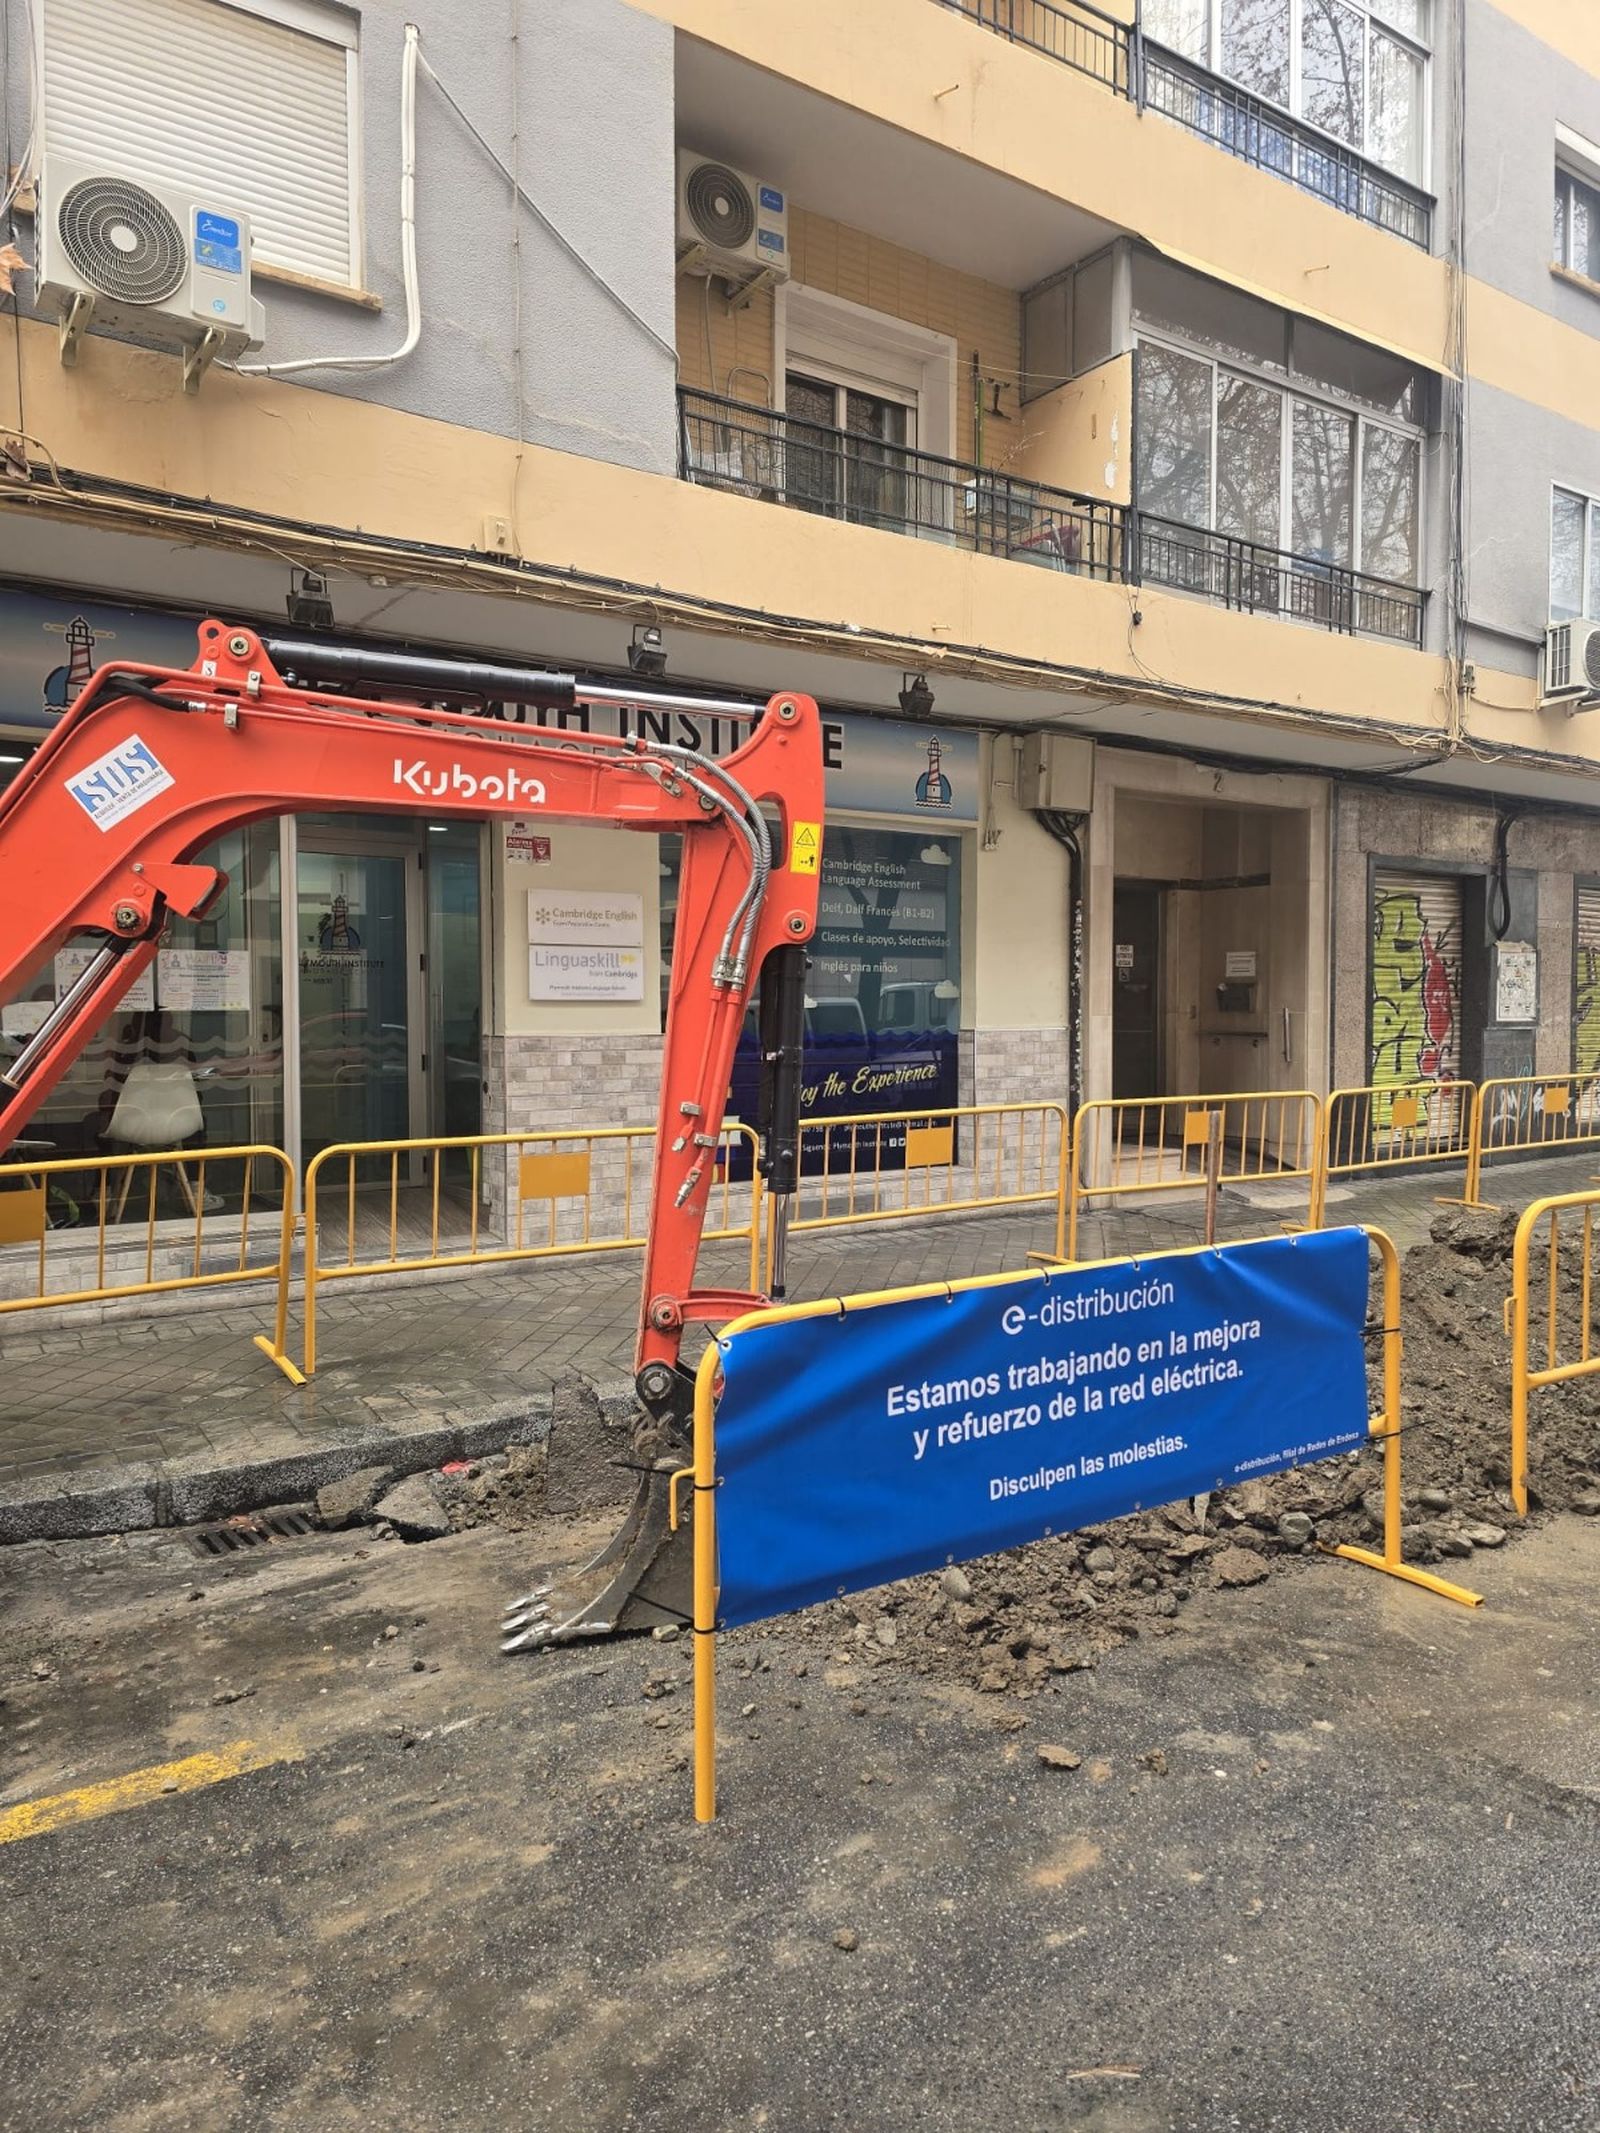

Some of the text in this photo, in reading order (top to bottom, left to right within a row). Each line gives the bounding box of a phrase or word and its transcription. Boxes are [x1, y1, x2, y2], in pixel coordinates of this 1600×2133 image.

[393, 759, 546, 803] Kubota
[822, 858, 907, 876] Cambridge English
[822, 874, 921, 890] Language Assessment
[552, 908, 638, 923] Cambridge English
[821, 931, 850, 943] Clases
[852, 933, 864, 944] de
[866, 935, 897, 947] apoyo,
[535, 951, 620, 971] Linguaskill
[821, 961, 898, 974] Inglés para niños
[822, 1071, 847, 1098] the
[1001, 1281, 1174, 1335] e-distribución
[886, 1320, 1262, 1416] Estamos trabajando en la mejora
[913, 1358, 1244, 1460] y refuerzo de la red eléctrica.
[1297, 1445, 1306, 1455] de
[1327, 1437, 1336, 1446] de
[990, 1433, 1188, 1500] Disculpen las molestias.
